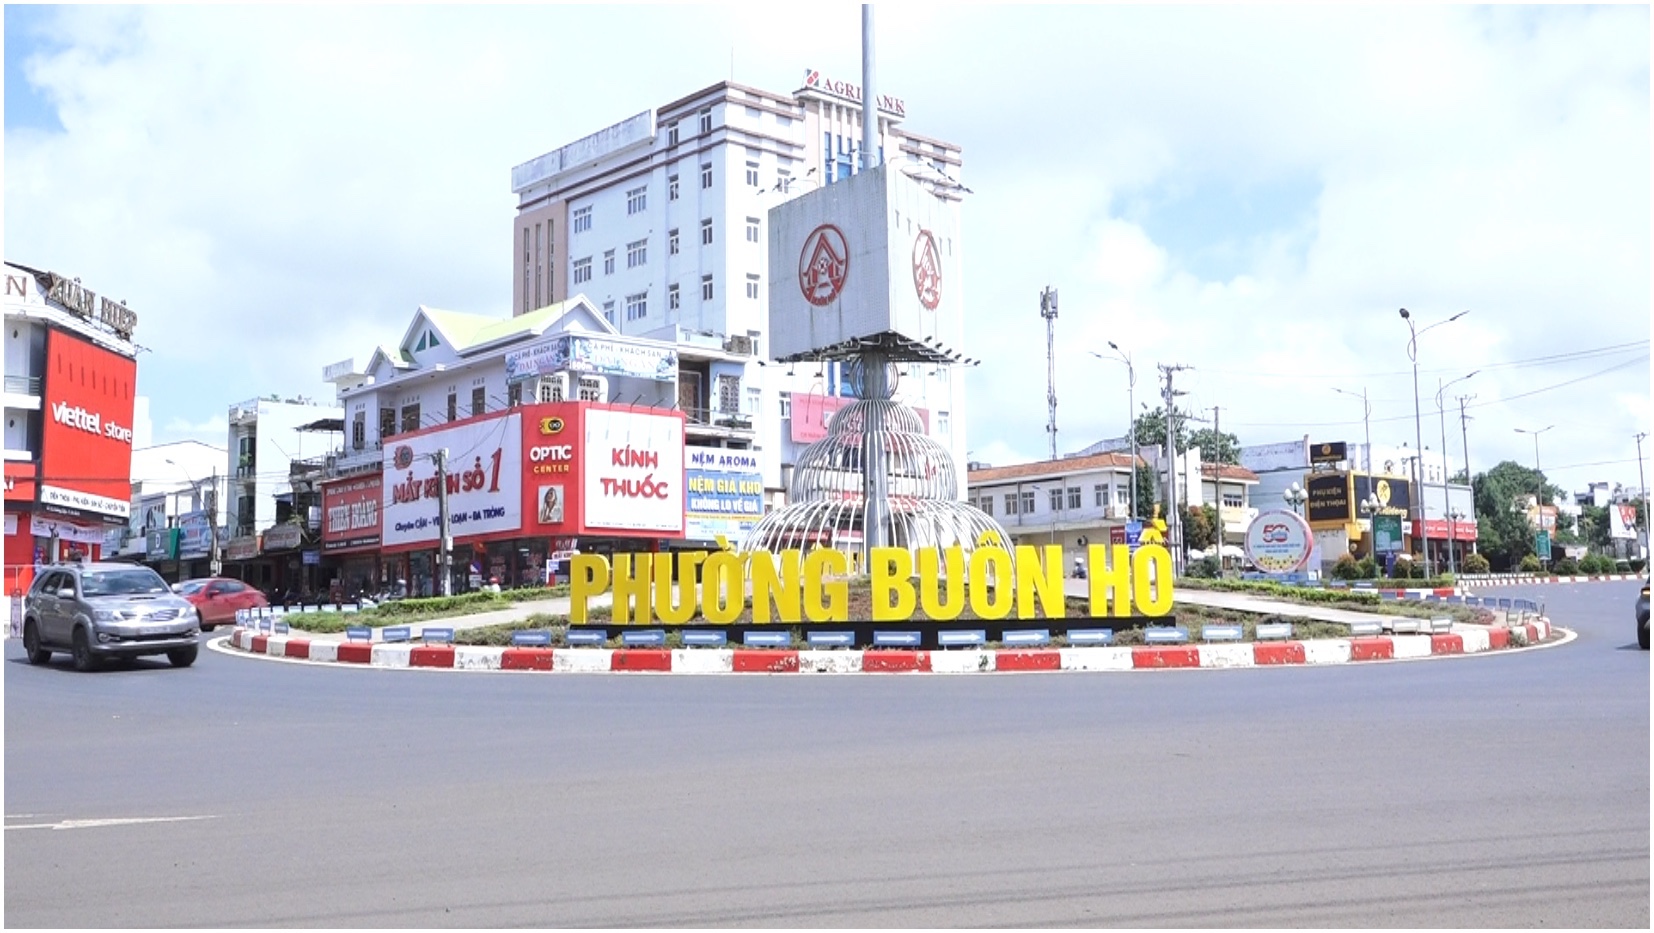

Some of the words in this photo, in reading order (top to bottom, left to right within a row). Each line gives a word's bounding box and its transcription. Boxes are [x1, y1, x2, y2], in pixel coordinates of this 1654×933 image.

[824, 78, 905, 114] AGRINK
[48, 271, 95, 318] XUÂN
[51, 401, 101, 435] viettel
[104, 421, 132, 443] store
[530, 445, 572, 462] OPTIC
[533, 464, 570, 474] CENTER
[612, 444, 659, 469] KÍNH
[692, 450, 714, 467] NỆM
[719, 455, 757, 468] AROMA
[487, 447, 502, 493] 1
[600, 473, 669, 499] THUỐC
[569, 534, 848, 625] PHƯỜNG
[870, 529, 1066, 621] BUÔN
[1088, 518, 1174, 618] HỒ
